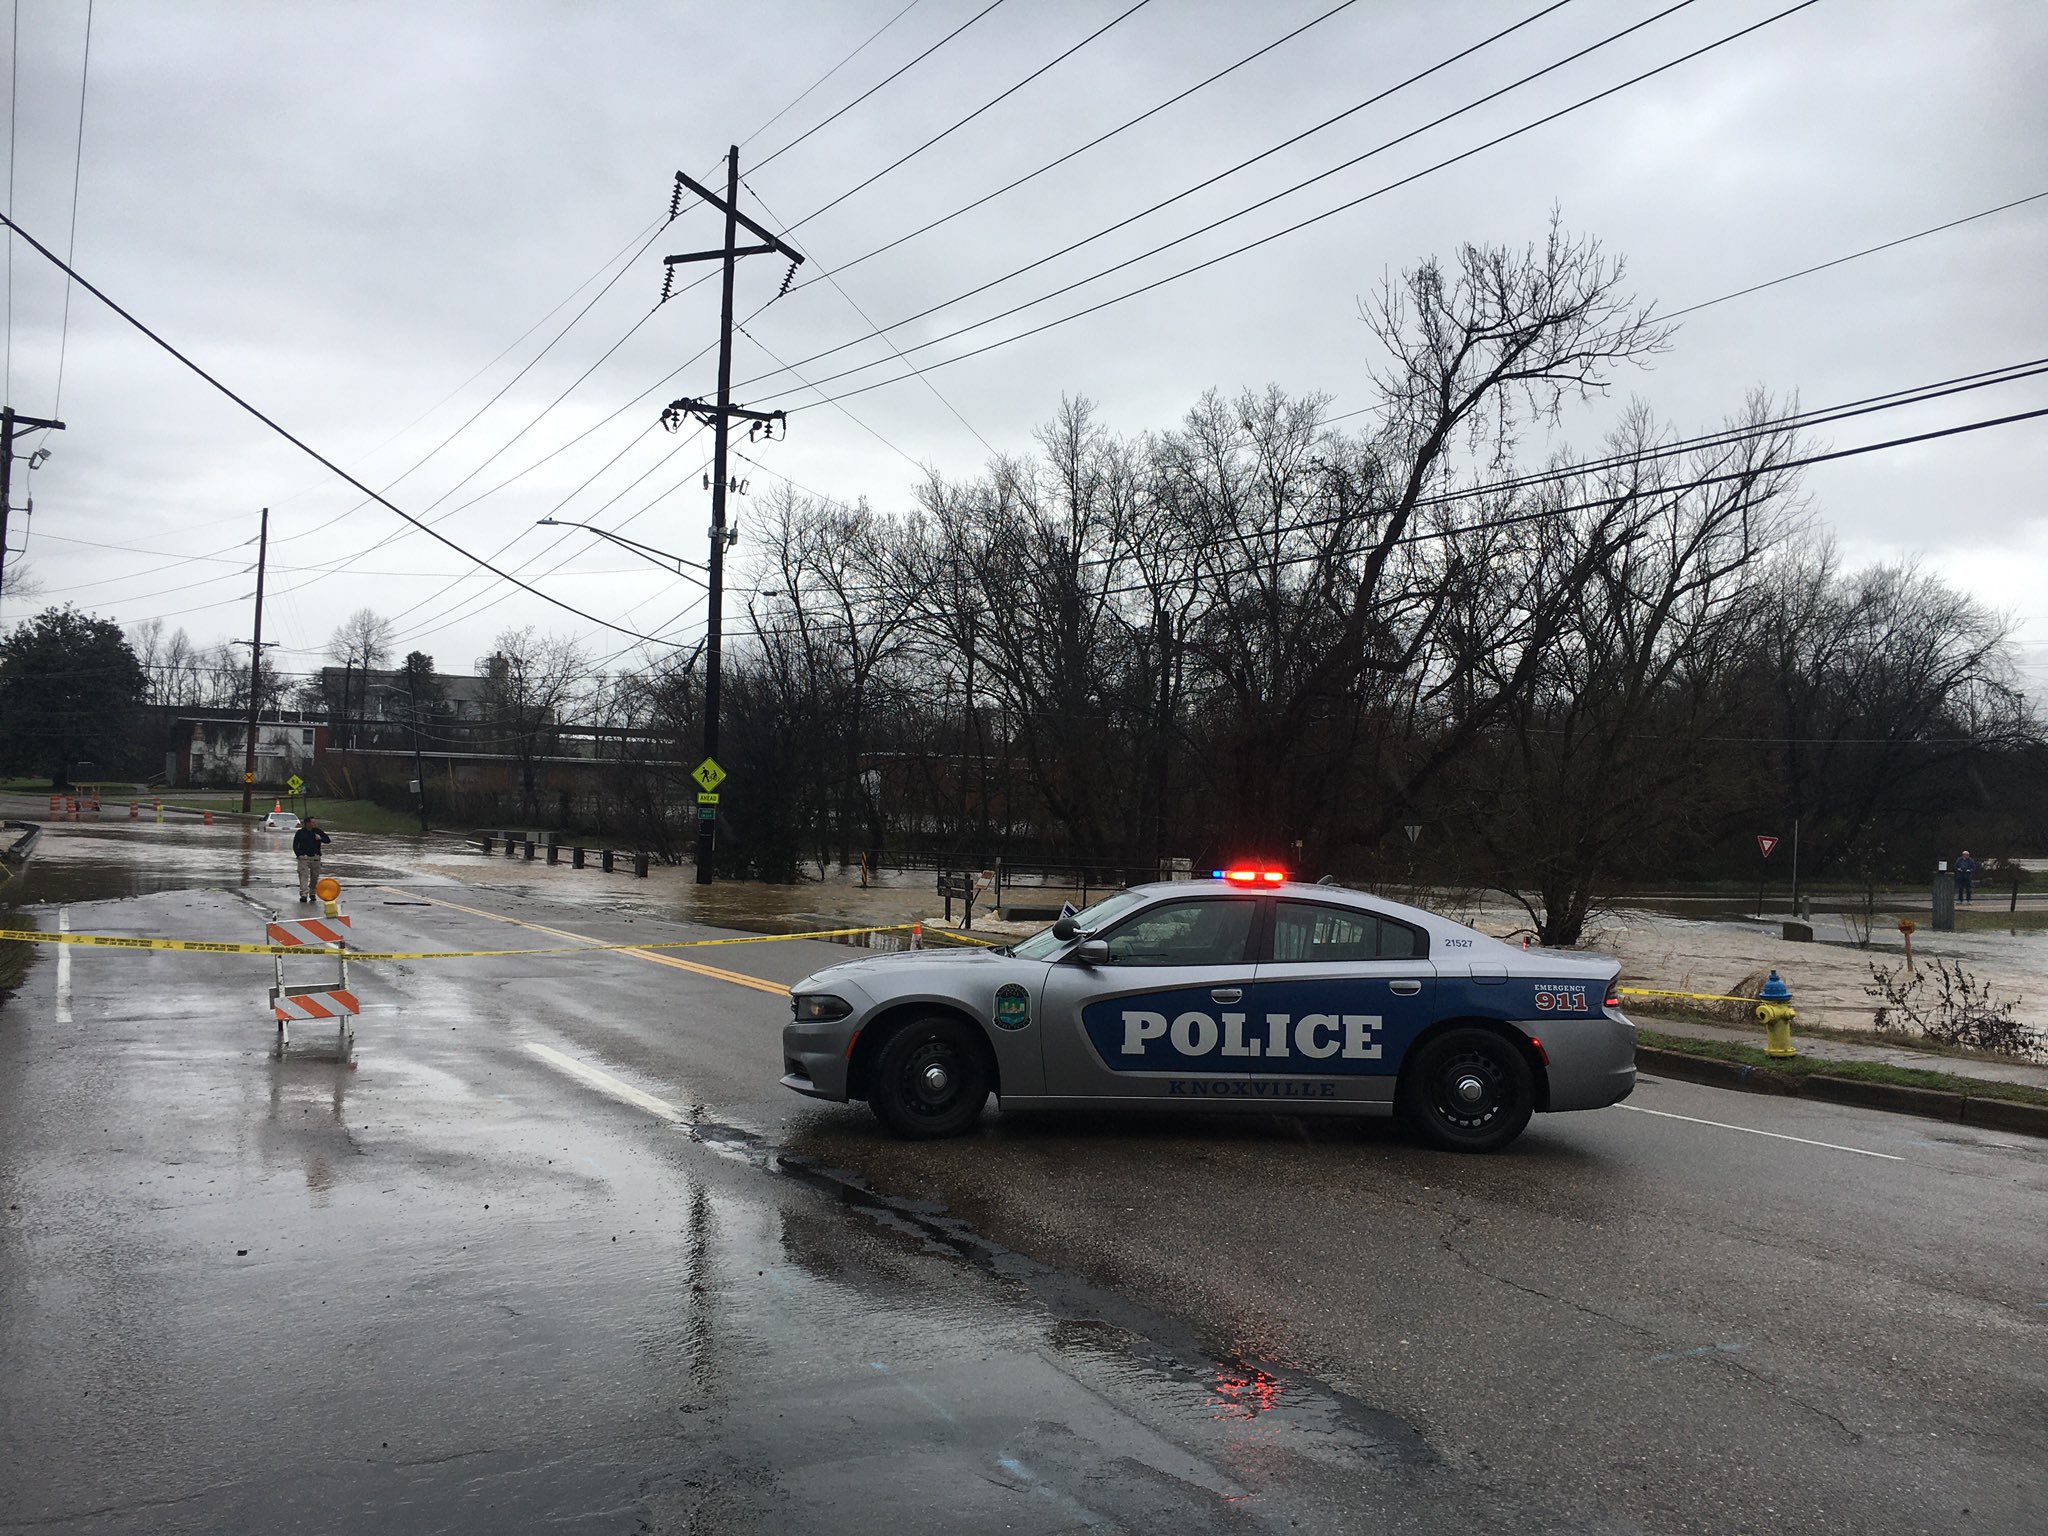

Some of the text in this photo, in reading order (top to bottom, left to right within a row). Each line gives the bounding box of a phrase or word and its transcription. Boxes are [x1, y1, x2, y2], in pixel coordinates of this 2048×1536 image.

[1444, 938, 1473, 948] 21527
[1534, 984, 1586, 992] EMERGENCY
[1535, 991, 1589, 1012] 911
[1121, 1010, 1383, 1059] POLICE
[1168, 1080, 1336, 1097] KNOXVILLE
